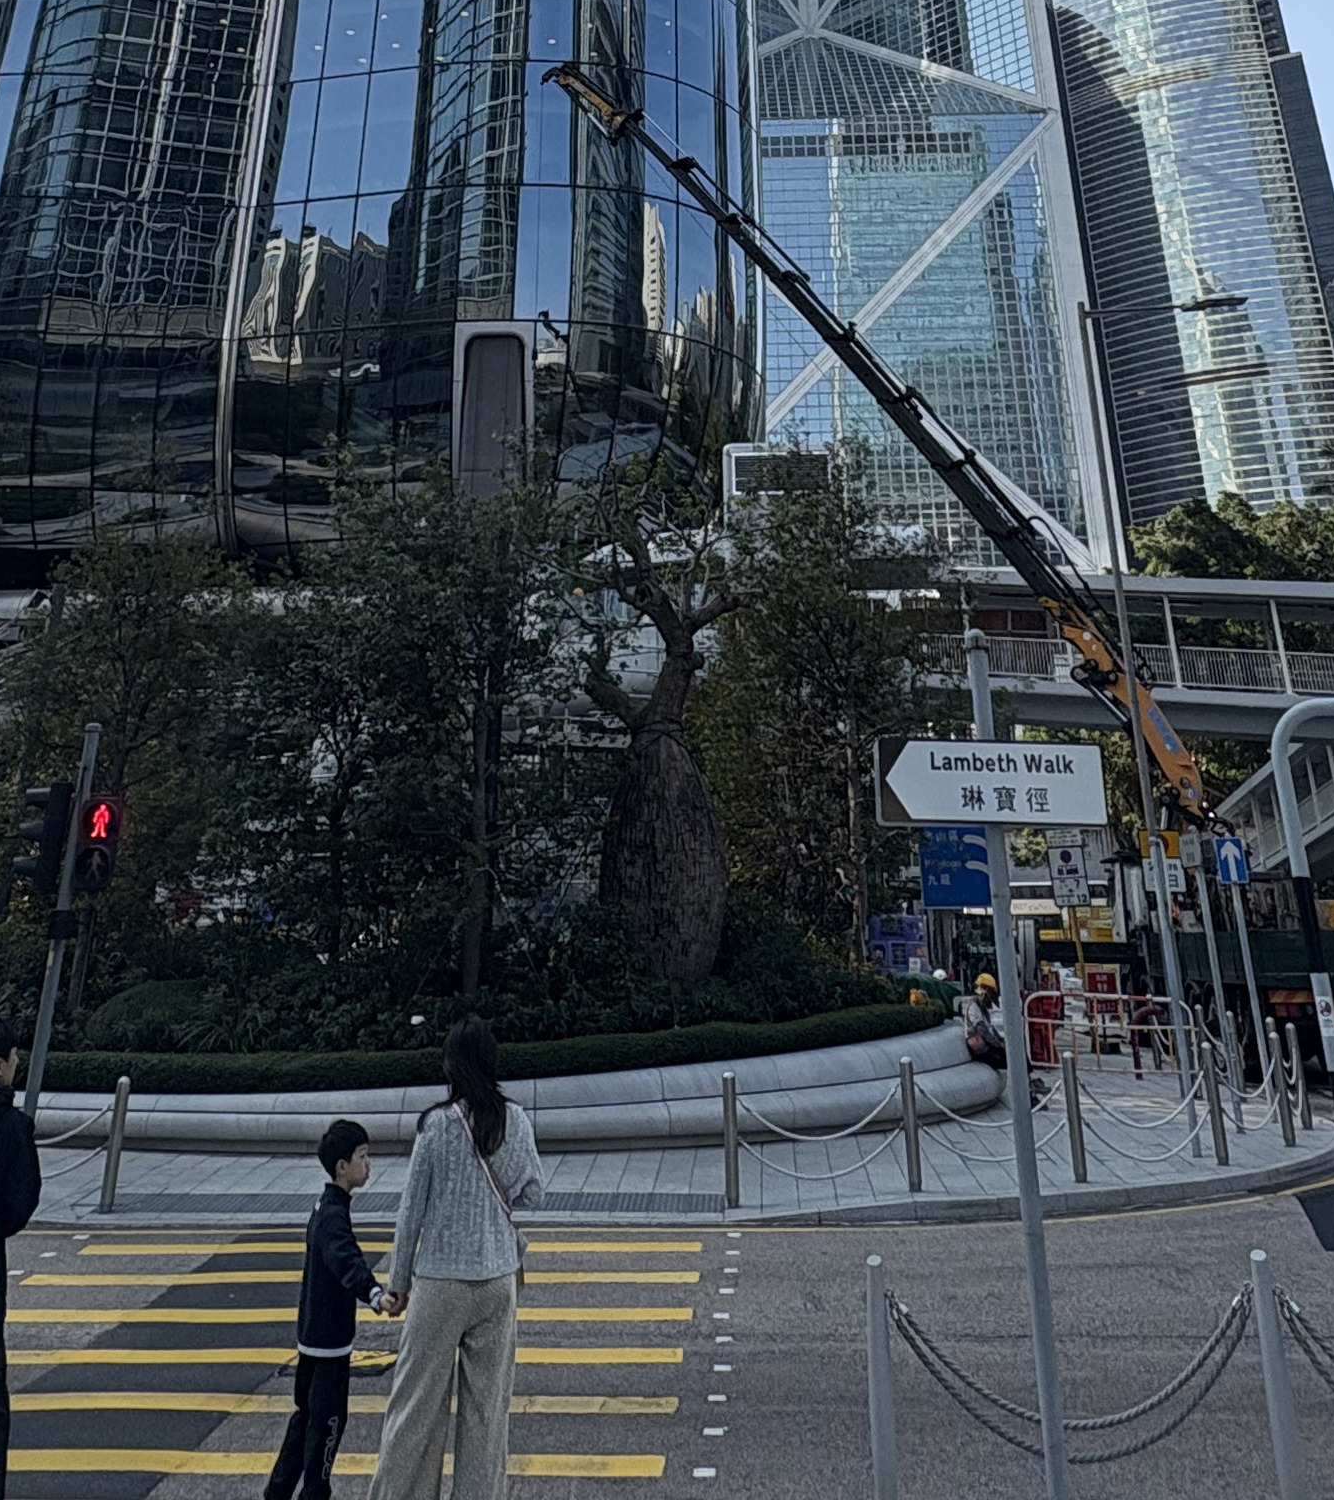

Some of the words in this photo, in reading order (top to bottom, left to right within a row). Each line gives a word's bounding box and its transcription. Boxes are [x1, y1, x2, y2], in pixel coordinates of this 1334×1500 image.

[929, 751, 1017, 773] Lambeth
[1024, 753, 1074, 775] Walk
[961, 785, 1051, 813] 琳寶徑
[1074, 879, 1080, 889] 7
[1077, 894, 1088, 903] 12
